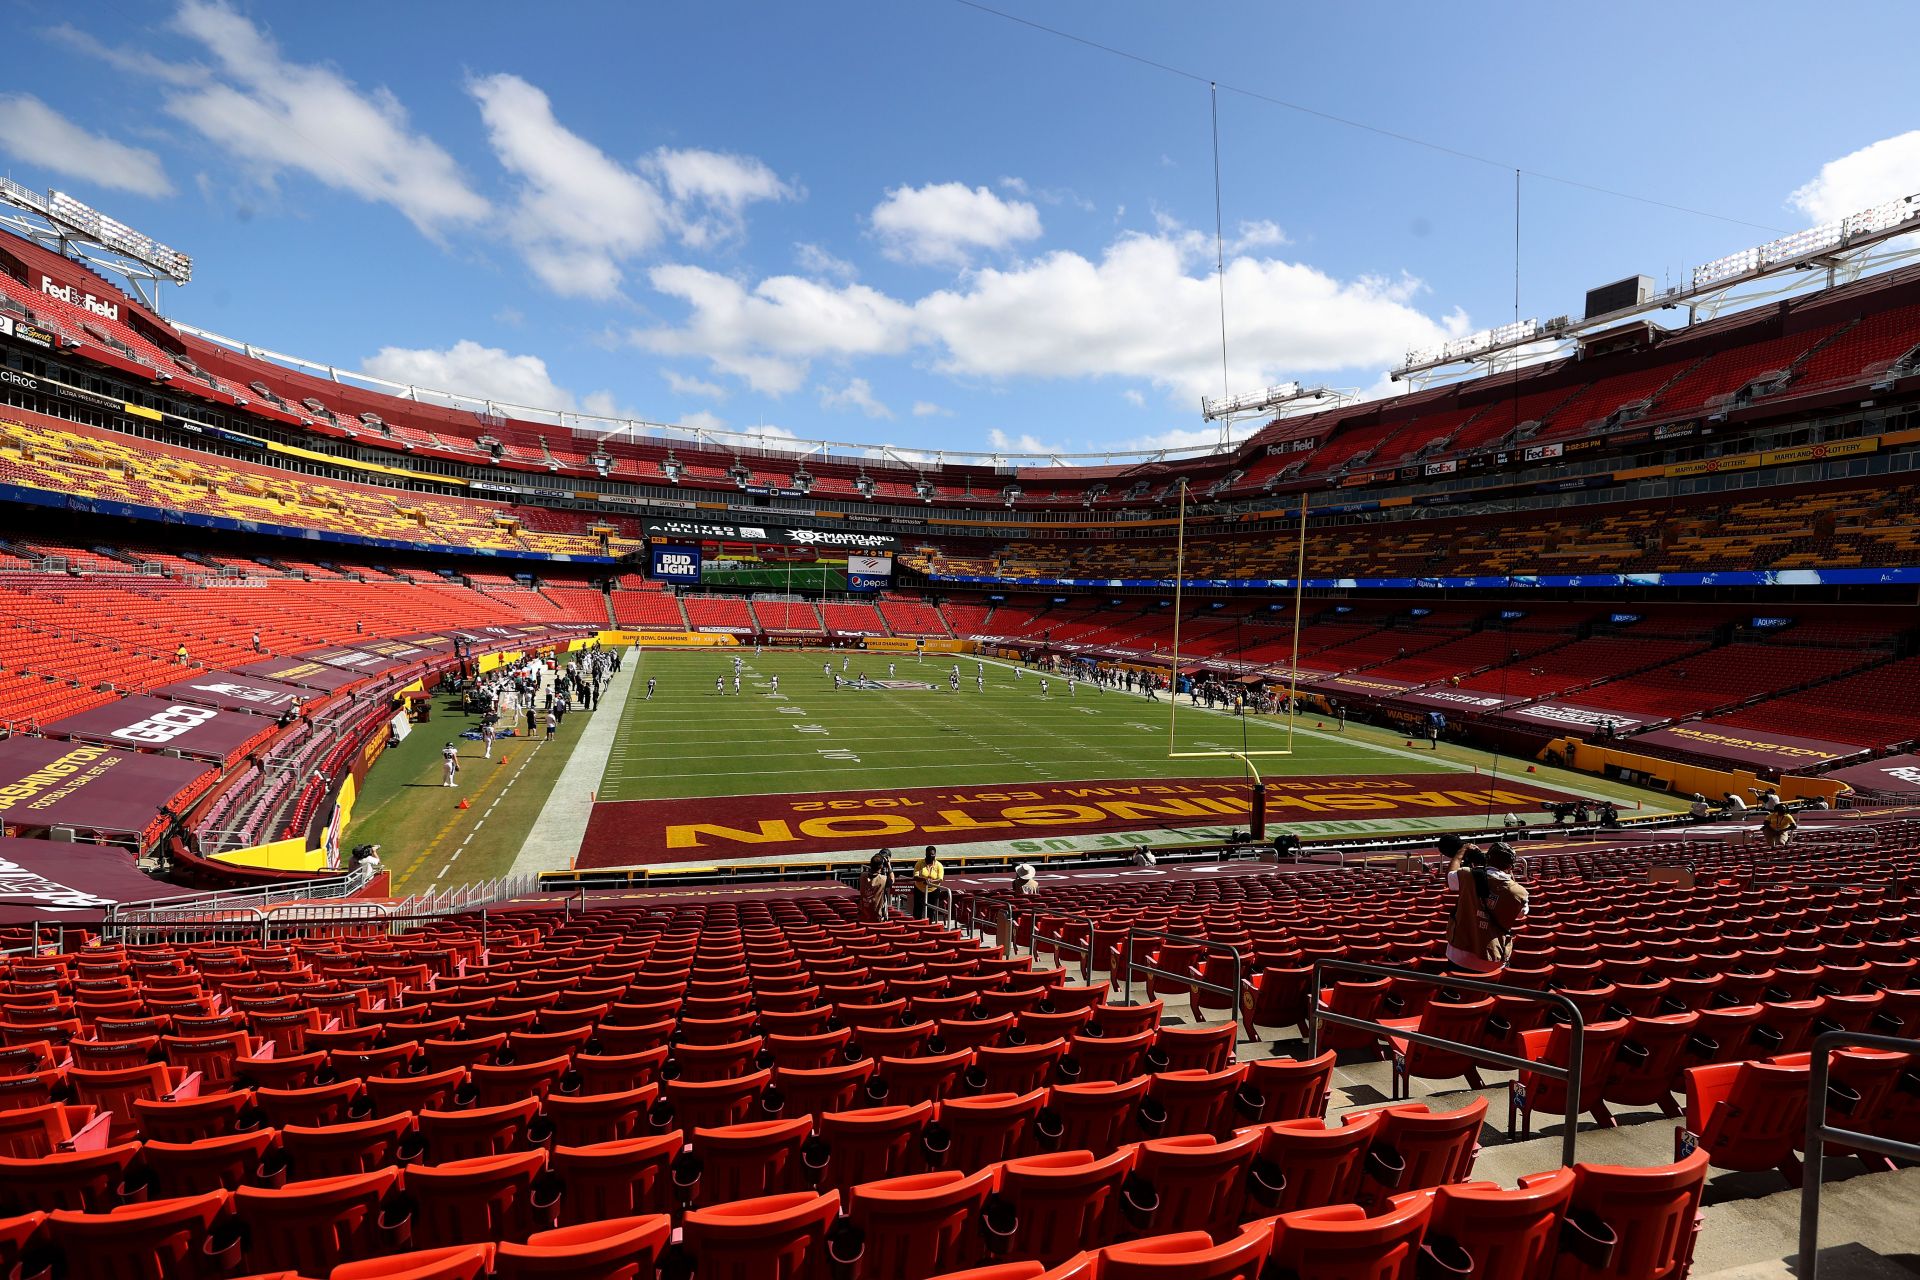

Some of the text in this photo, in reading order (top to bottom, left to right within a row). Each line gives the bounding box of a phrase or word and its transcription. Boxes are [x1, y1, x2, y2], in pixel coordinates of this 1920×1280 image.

[42, 276, 118, 320] FedExField
[1655, 430, 1692, 440] WASHINGTON
[1527, 447, 1556, 459] FedEx
[1775, 450, 1811, 461] MARYLAND
[1427, 463, 1452, 475] FedEx
[1675, 464, 1705, 473] MARYLAND
[481, 482, 564, 498] GEICO GEICO
[649, 525, 735, 537] AIRLINES
[667, 522, 735, 532] UNITED
[823, 532, 894, 542] MARYLAND
[662, 554, 691, 565] BUD
[863, 579, 888, 588] pepsi
[111, 705, 218, 743] GEICO
[1668, 728, 1838, 758] WASHINGTON
[0, 746, 109, 813] ASHINGTON
[790, 797, 924, 811] 1932
[666, 789, 1554, 849] WASHINGTON
[1009, 839, 1077, 852] US
[1095, 833, 1153, 847] OF
